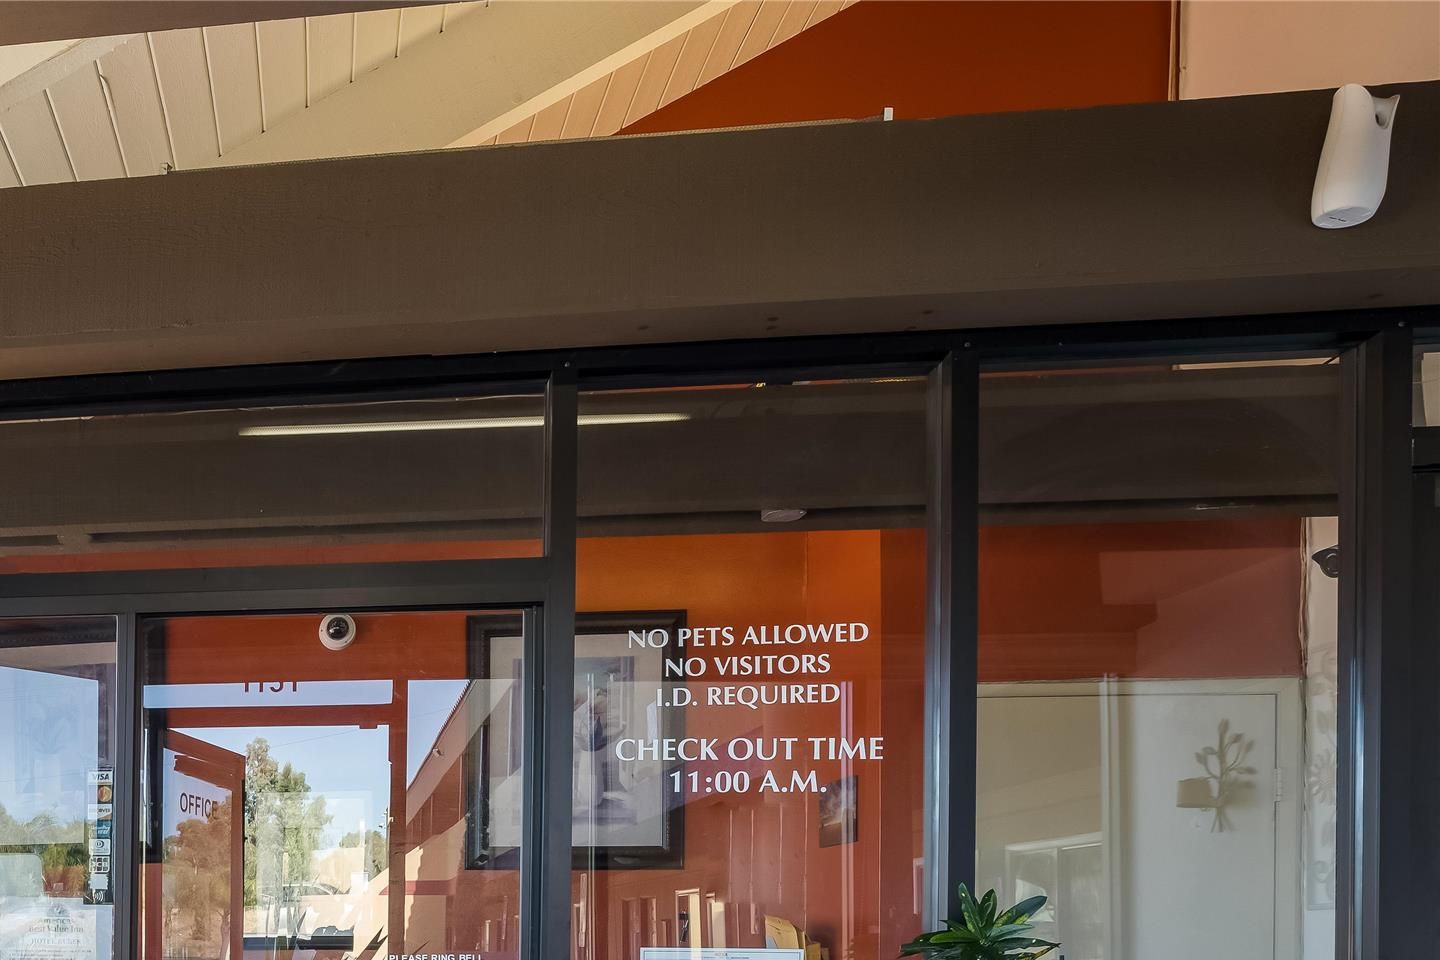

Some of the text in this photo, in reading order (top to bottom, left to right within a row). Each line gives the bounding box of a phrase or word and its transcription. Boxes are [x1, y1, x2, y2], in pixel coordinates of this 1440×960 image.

[628, 622, 870, 649] NO PETS ALLOWED
[665, 653, 831, 678] NO VISITORS
[656, 683, 841, 710] I.D. REQUIRED
[615, 736, 885, 762] CHECK OUT TIME
[670, 769, 828, 794] 11:00 A.M.
[179, 791, 219, 821] OFFICE
